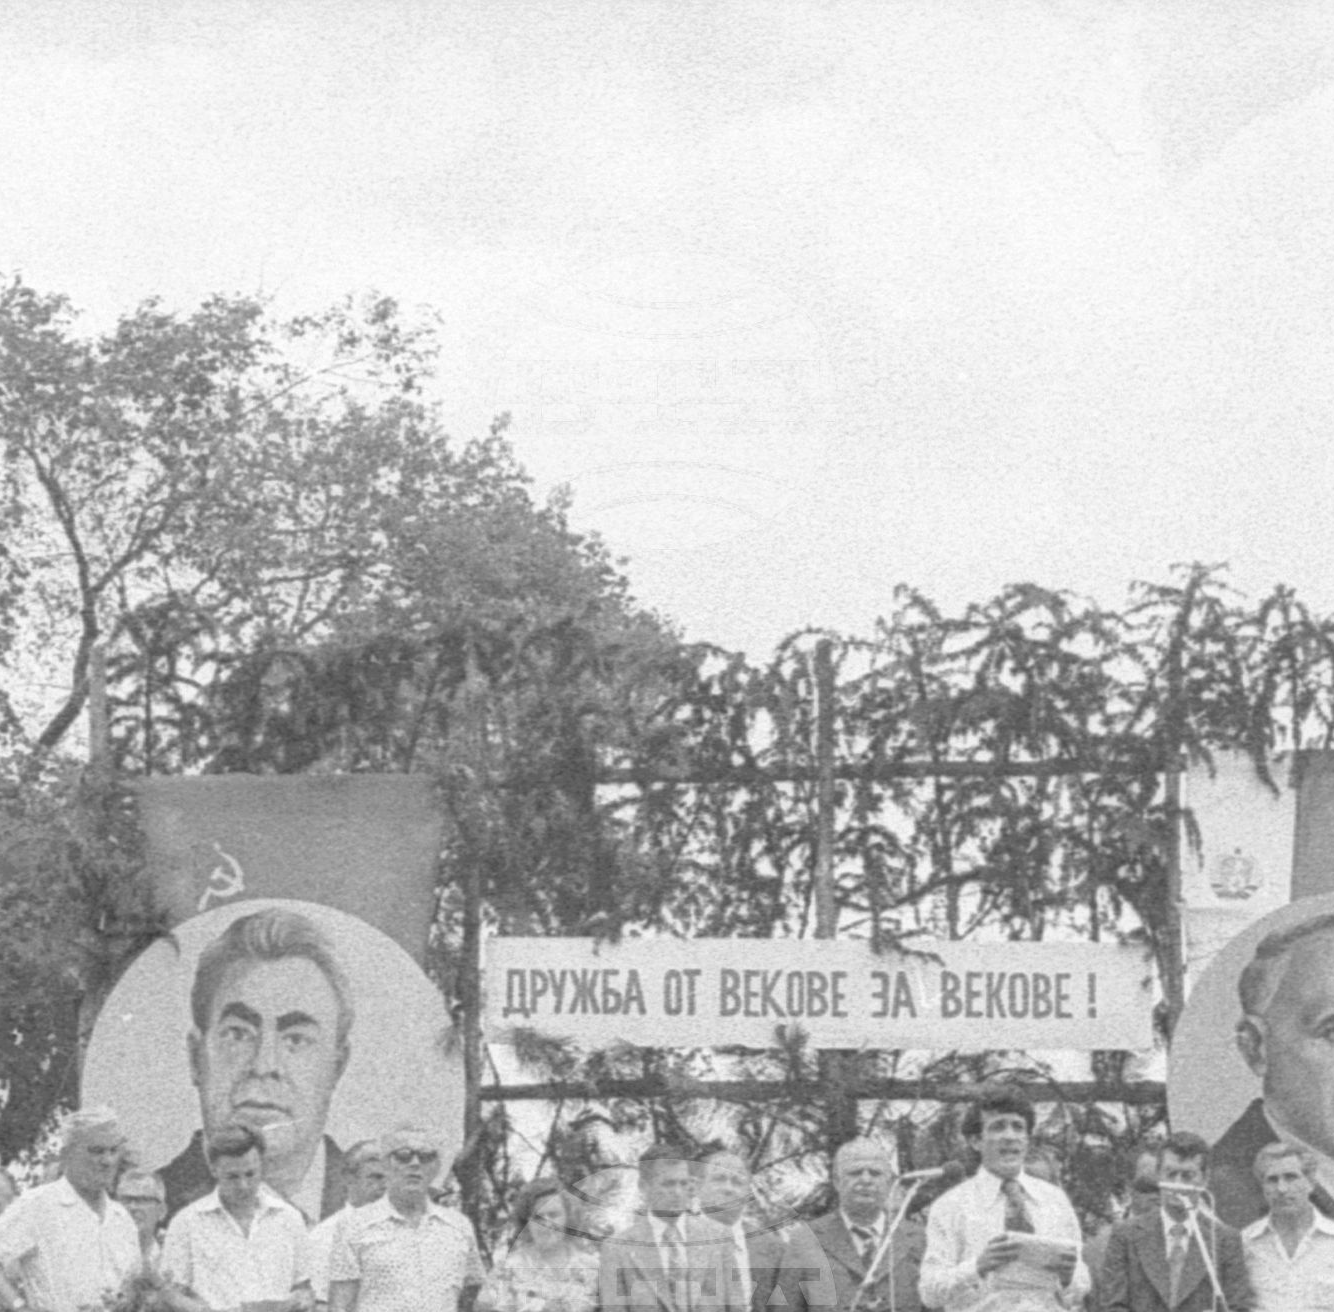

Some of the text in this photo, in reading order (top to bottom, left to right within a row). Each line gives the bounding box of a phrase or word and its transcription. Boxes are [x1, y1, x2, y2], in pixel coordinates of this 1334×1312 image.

[501, 968, 647, 1019] ДРУЖБА
[663, 968, 702, 1016] ОТ
[719, 968, 849, 1018] ВЕКОВЕ
[870, 970, 918, 1018] ЗА
